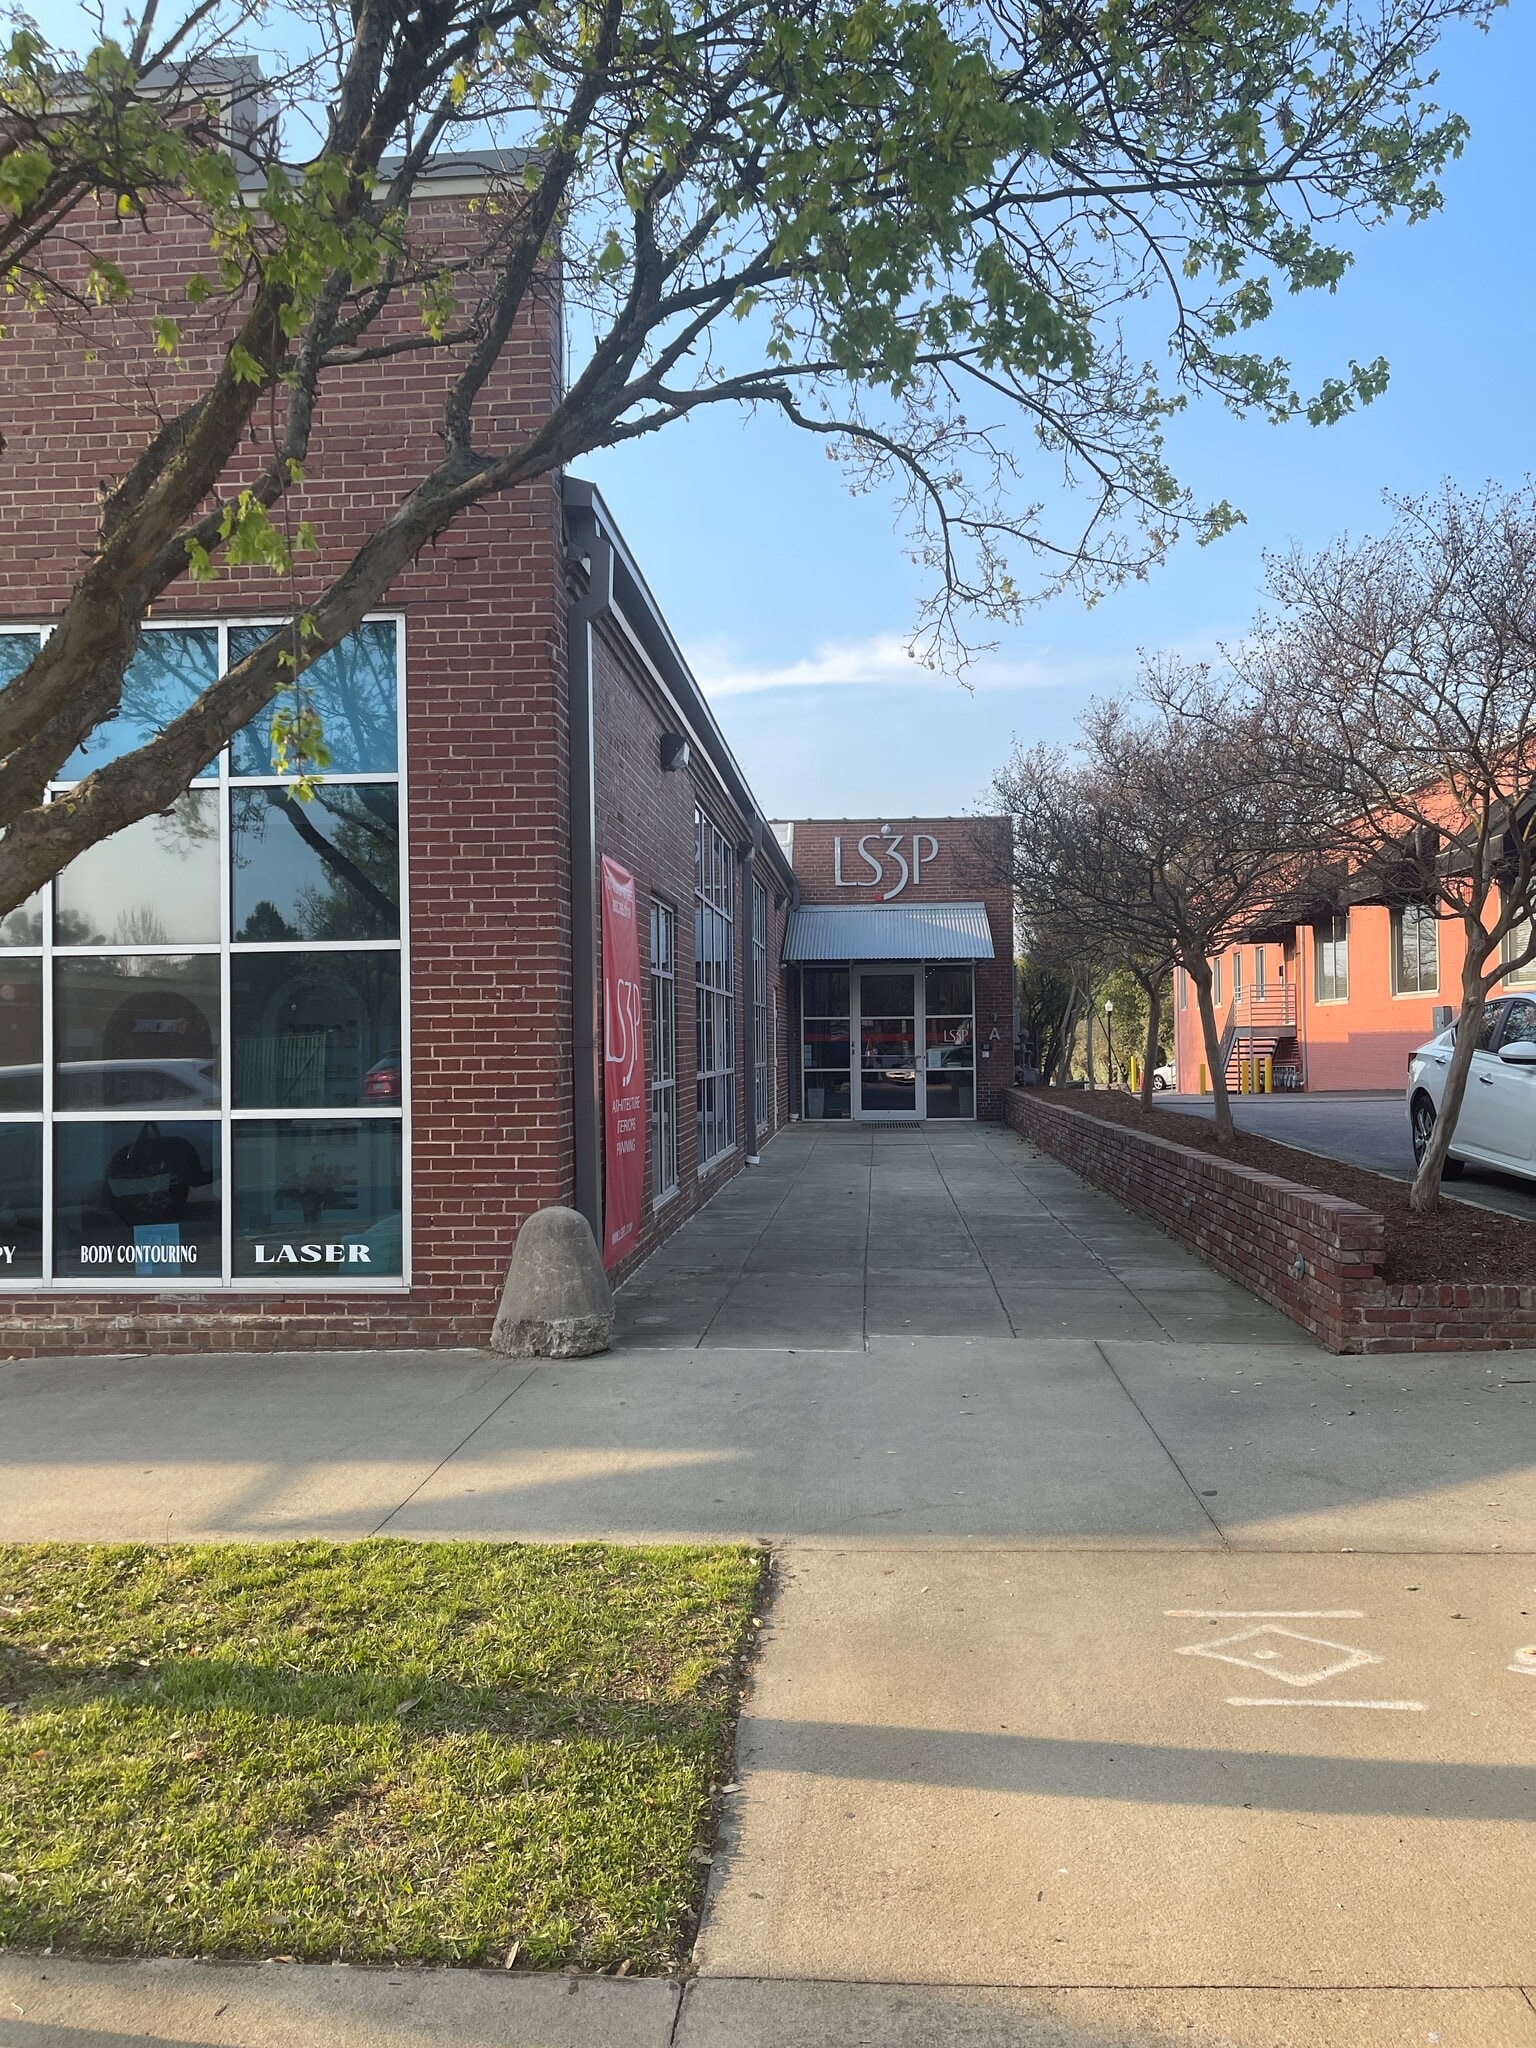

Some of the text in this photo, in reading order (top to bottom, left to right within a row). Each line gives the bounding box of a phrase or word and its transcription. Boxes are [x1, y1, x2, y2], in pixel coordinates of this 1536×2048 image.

[834, 833, 939, 901] LS3P
[943, 1029, 969, 1046] LS3P
[989, 1027, 1001, 1040] A
[80, 1245, 197, 1263] BODY CONTOURING
[254, 1244, 372, 1263] LASER
